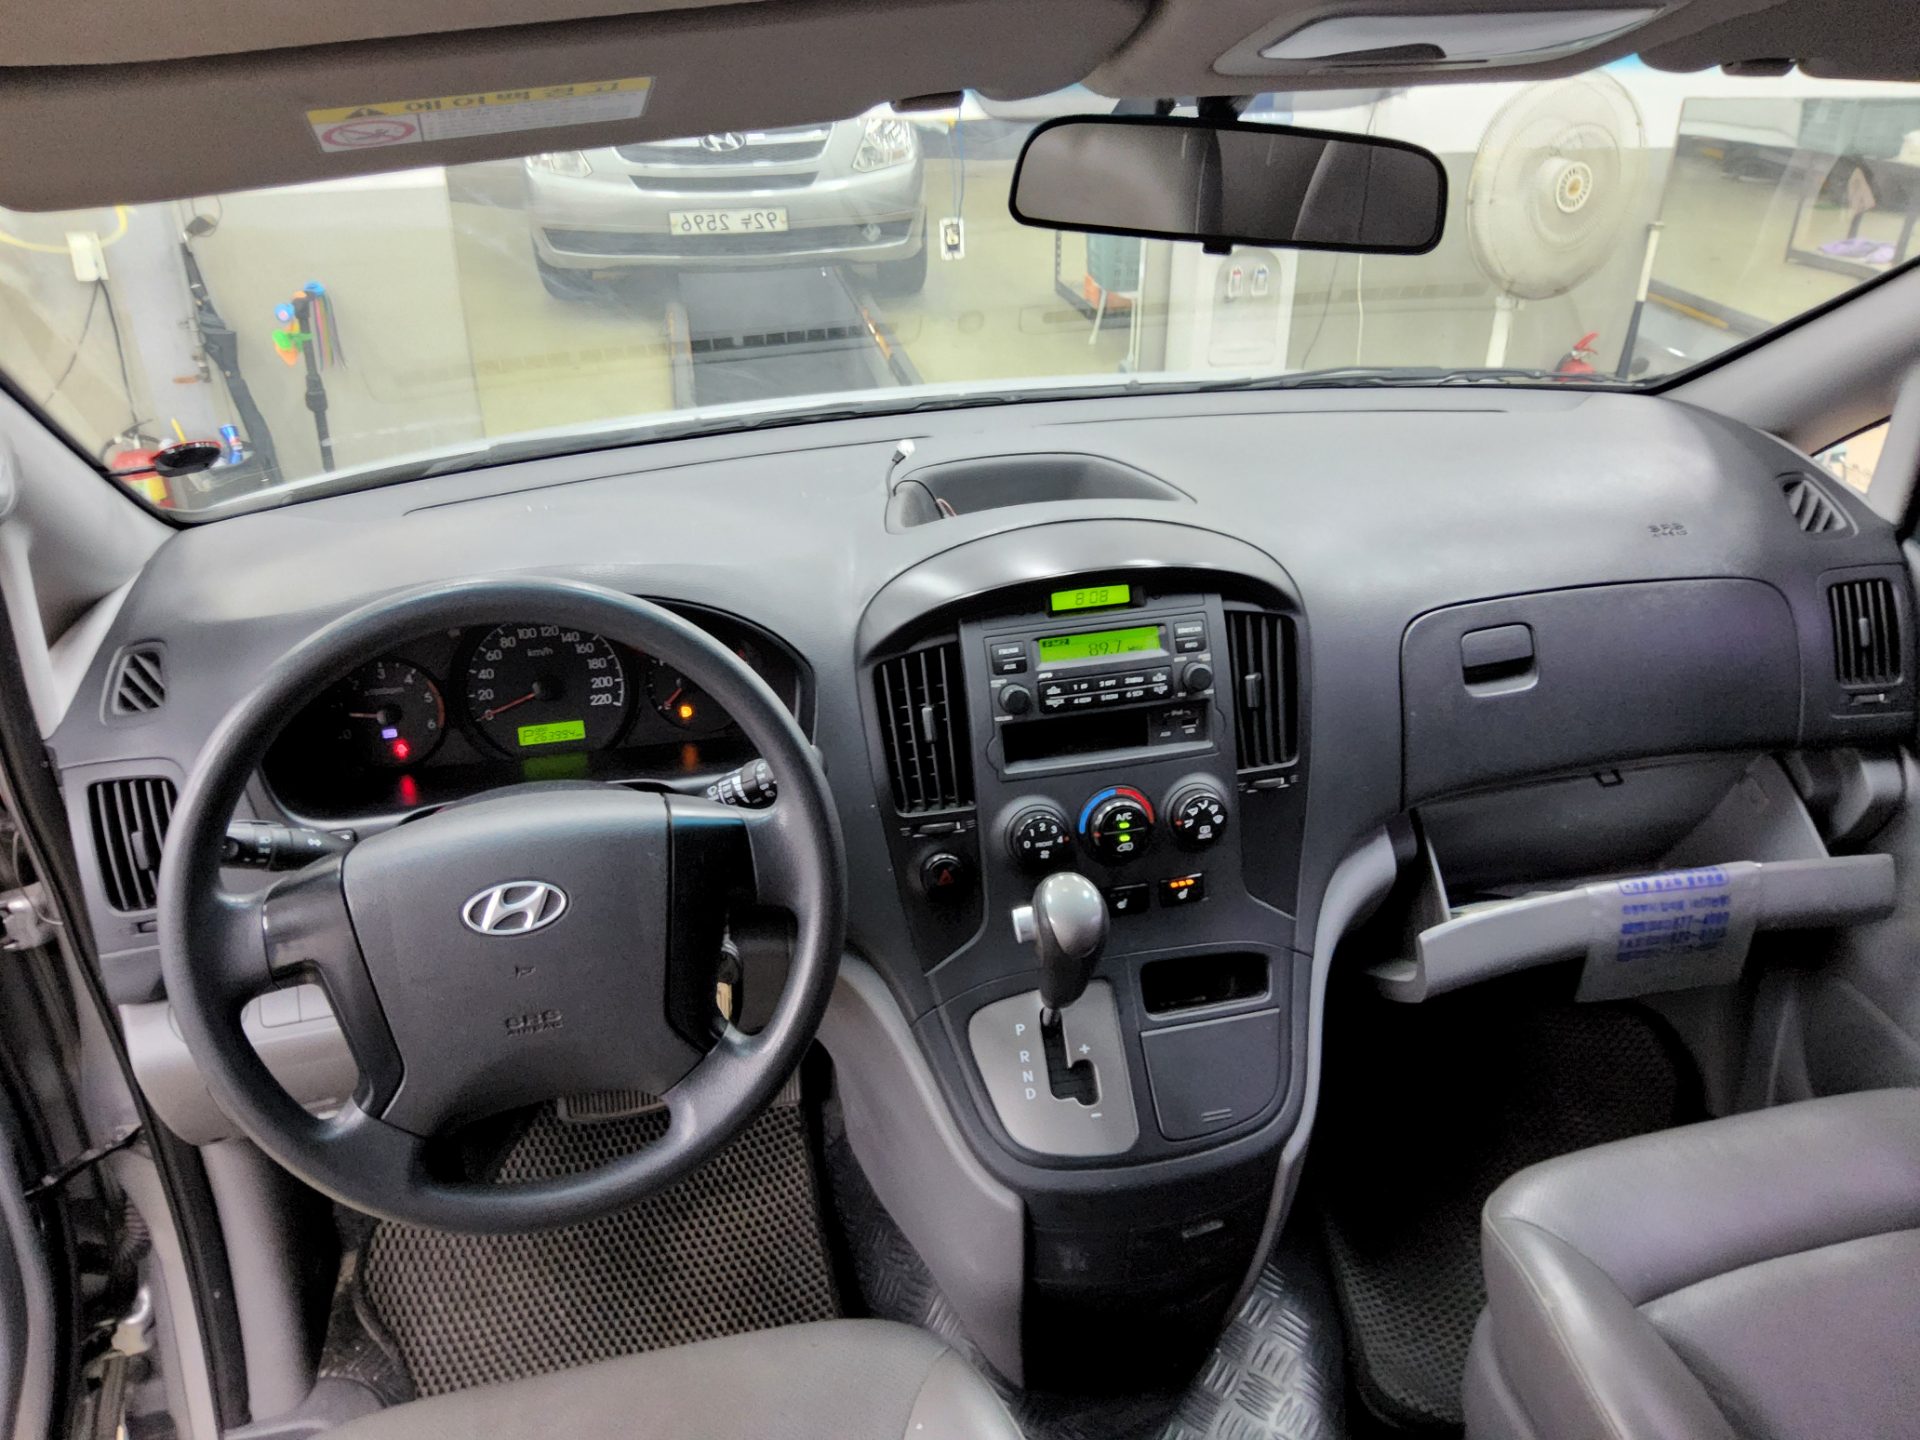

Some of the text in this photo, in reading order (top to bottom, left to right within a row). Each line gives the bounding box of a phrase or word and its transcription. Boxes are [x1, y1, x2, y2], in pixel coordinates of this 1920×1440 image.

[517, 628, 537, 639] 100
[541, 625, 559, 637] 120
[561, 631, 580, 643] 140
[500, 636, 516, 648] 80
[575, 642, 595, 654] 160
[1089, 640, 1122, 656] 89.7
[485, 650, 502, 661] 60
[527, 647, 553, 657] km/h
[587, 657, 607, 669] 180
[478, 668, 494, 679] 40
[590, 676, 613, 689] 200
[424, 692, 433, 703] 5
[478, 688, 494, 701] 20
[590, 693, 612, 706] 220
[427, 720, 437, 730] 6
[1116, 812, 1132, 821] A/C
[1029, 828, 1035, 837] 1
[1039, 822, 1047, 832] 2
[1050, 825, 1058, 834] 3
[1023, 840, 1031, 849] 0
[1015, 1023, 1026, 1036] P
[1020, 1050, 1030, 1063] R
[1022, 1070, 1034, 1083] N
[1025, 1088, 1037, 1100] D
